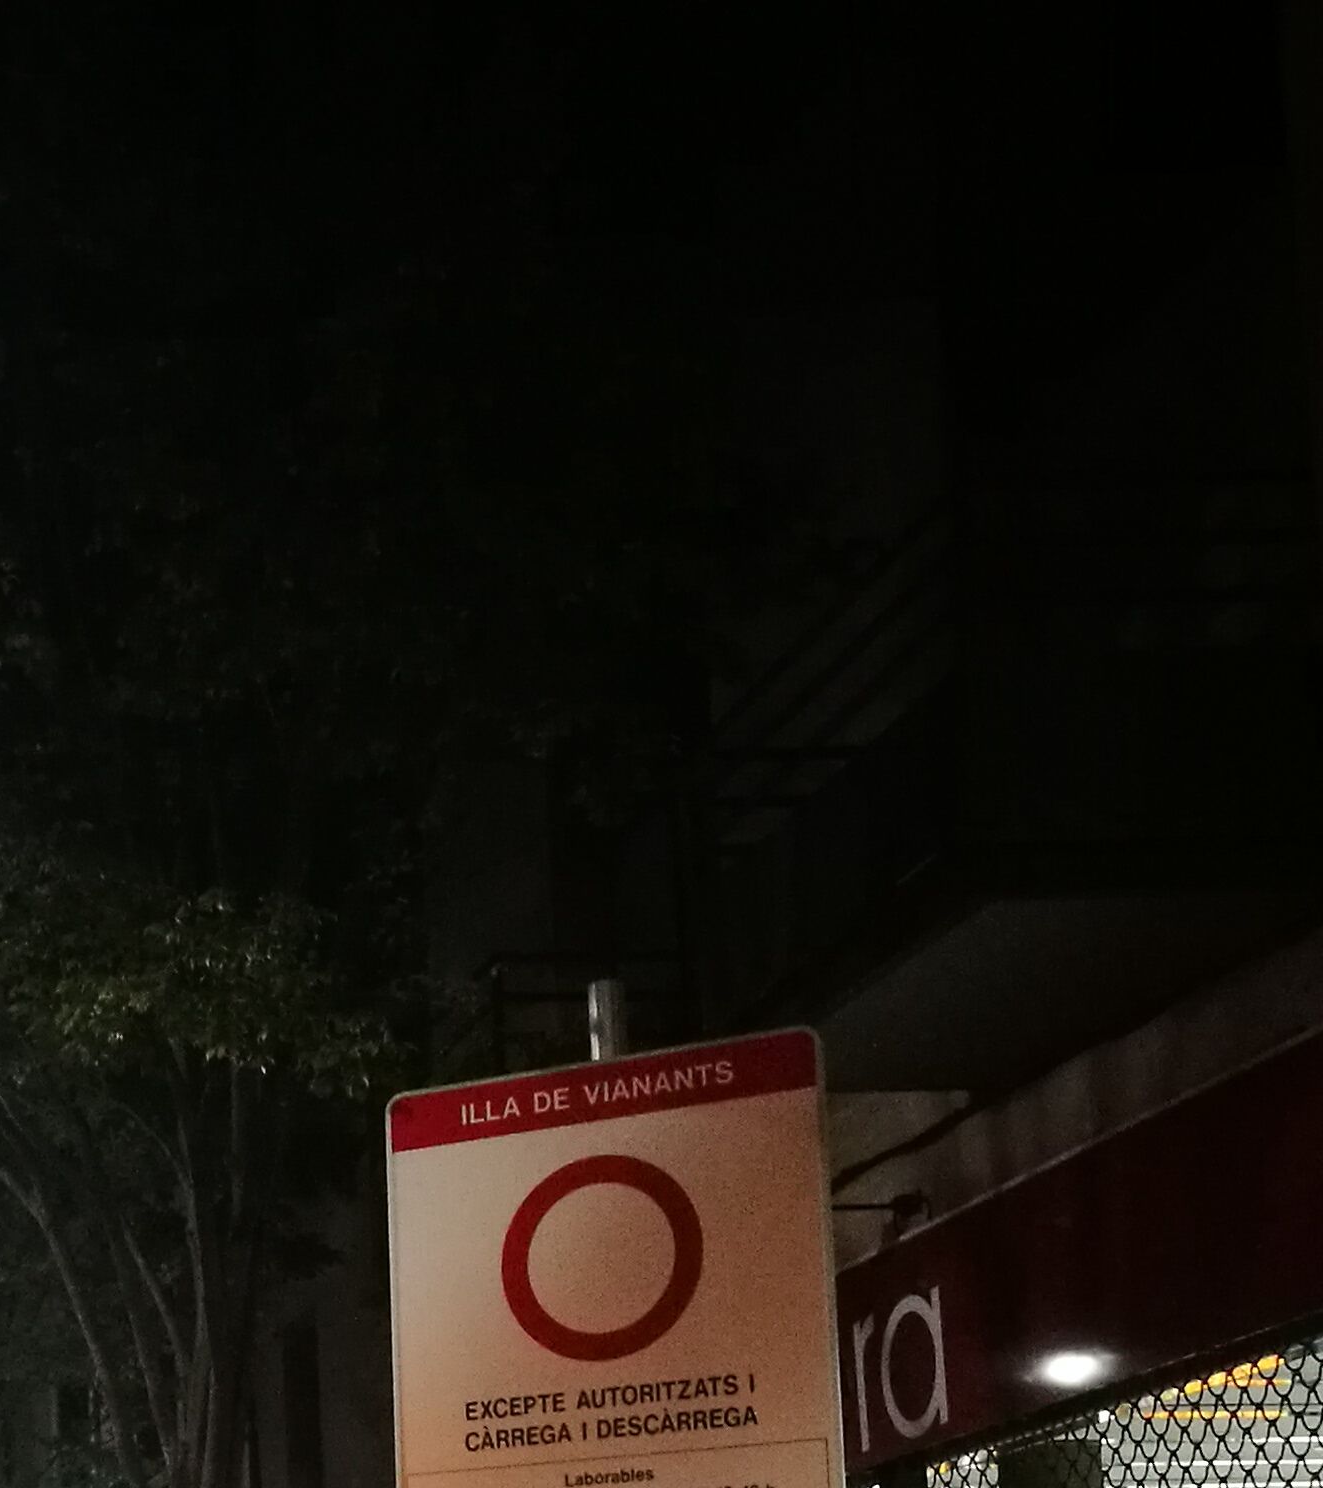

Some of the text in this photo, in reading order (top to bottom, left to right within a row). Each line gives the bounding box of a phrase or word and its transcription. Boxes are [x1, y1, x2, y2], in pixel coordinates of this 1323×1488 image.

[460, 1060, 735, 1126] ILLA DE VIANANTS
[465, 1373, 756, 1421] EXCEPTE AUTORITZATS I
[465, 1405, 759, 1453] CÀRREGA I DESCÀRREGA
[564, 1468, 655, 1488] Laborables
